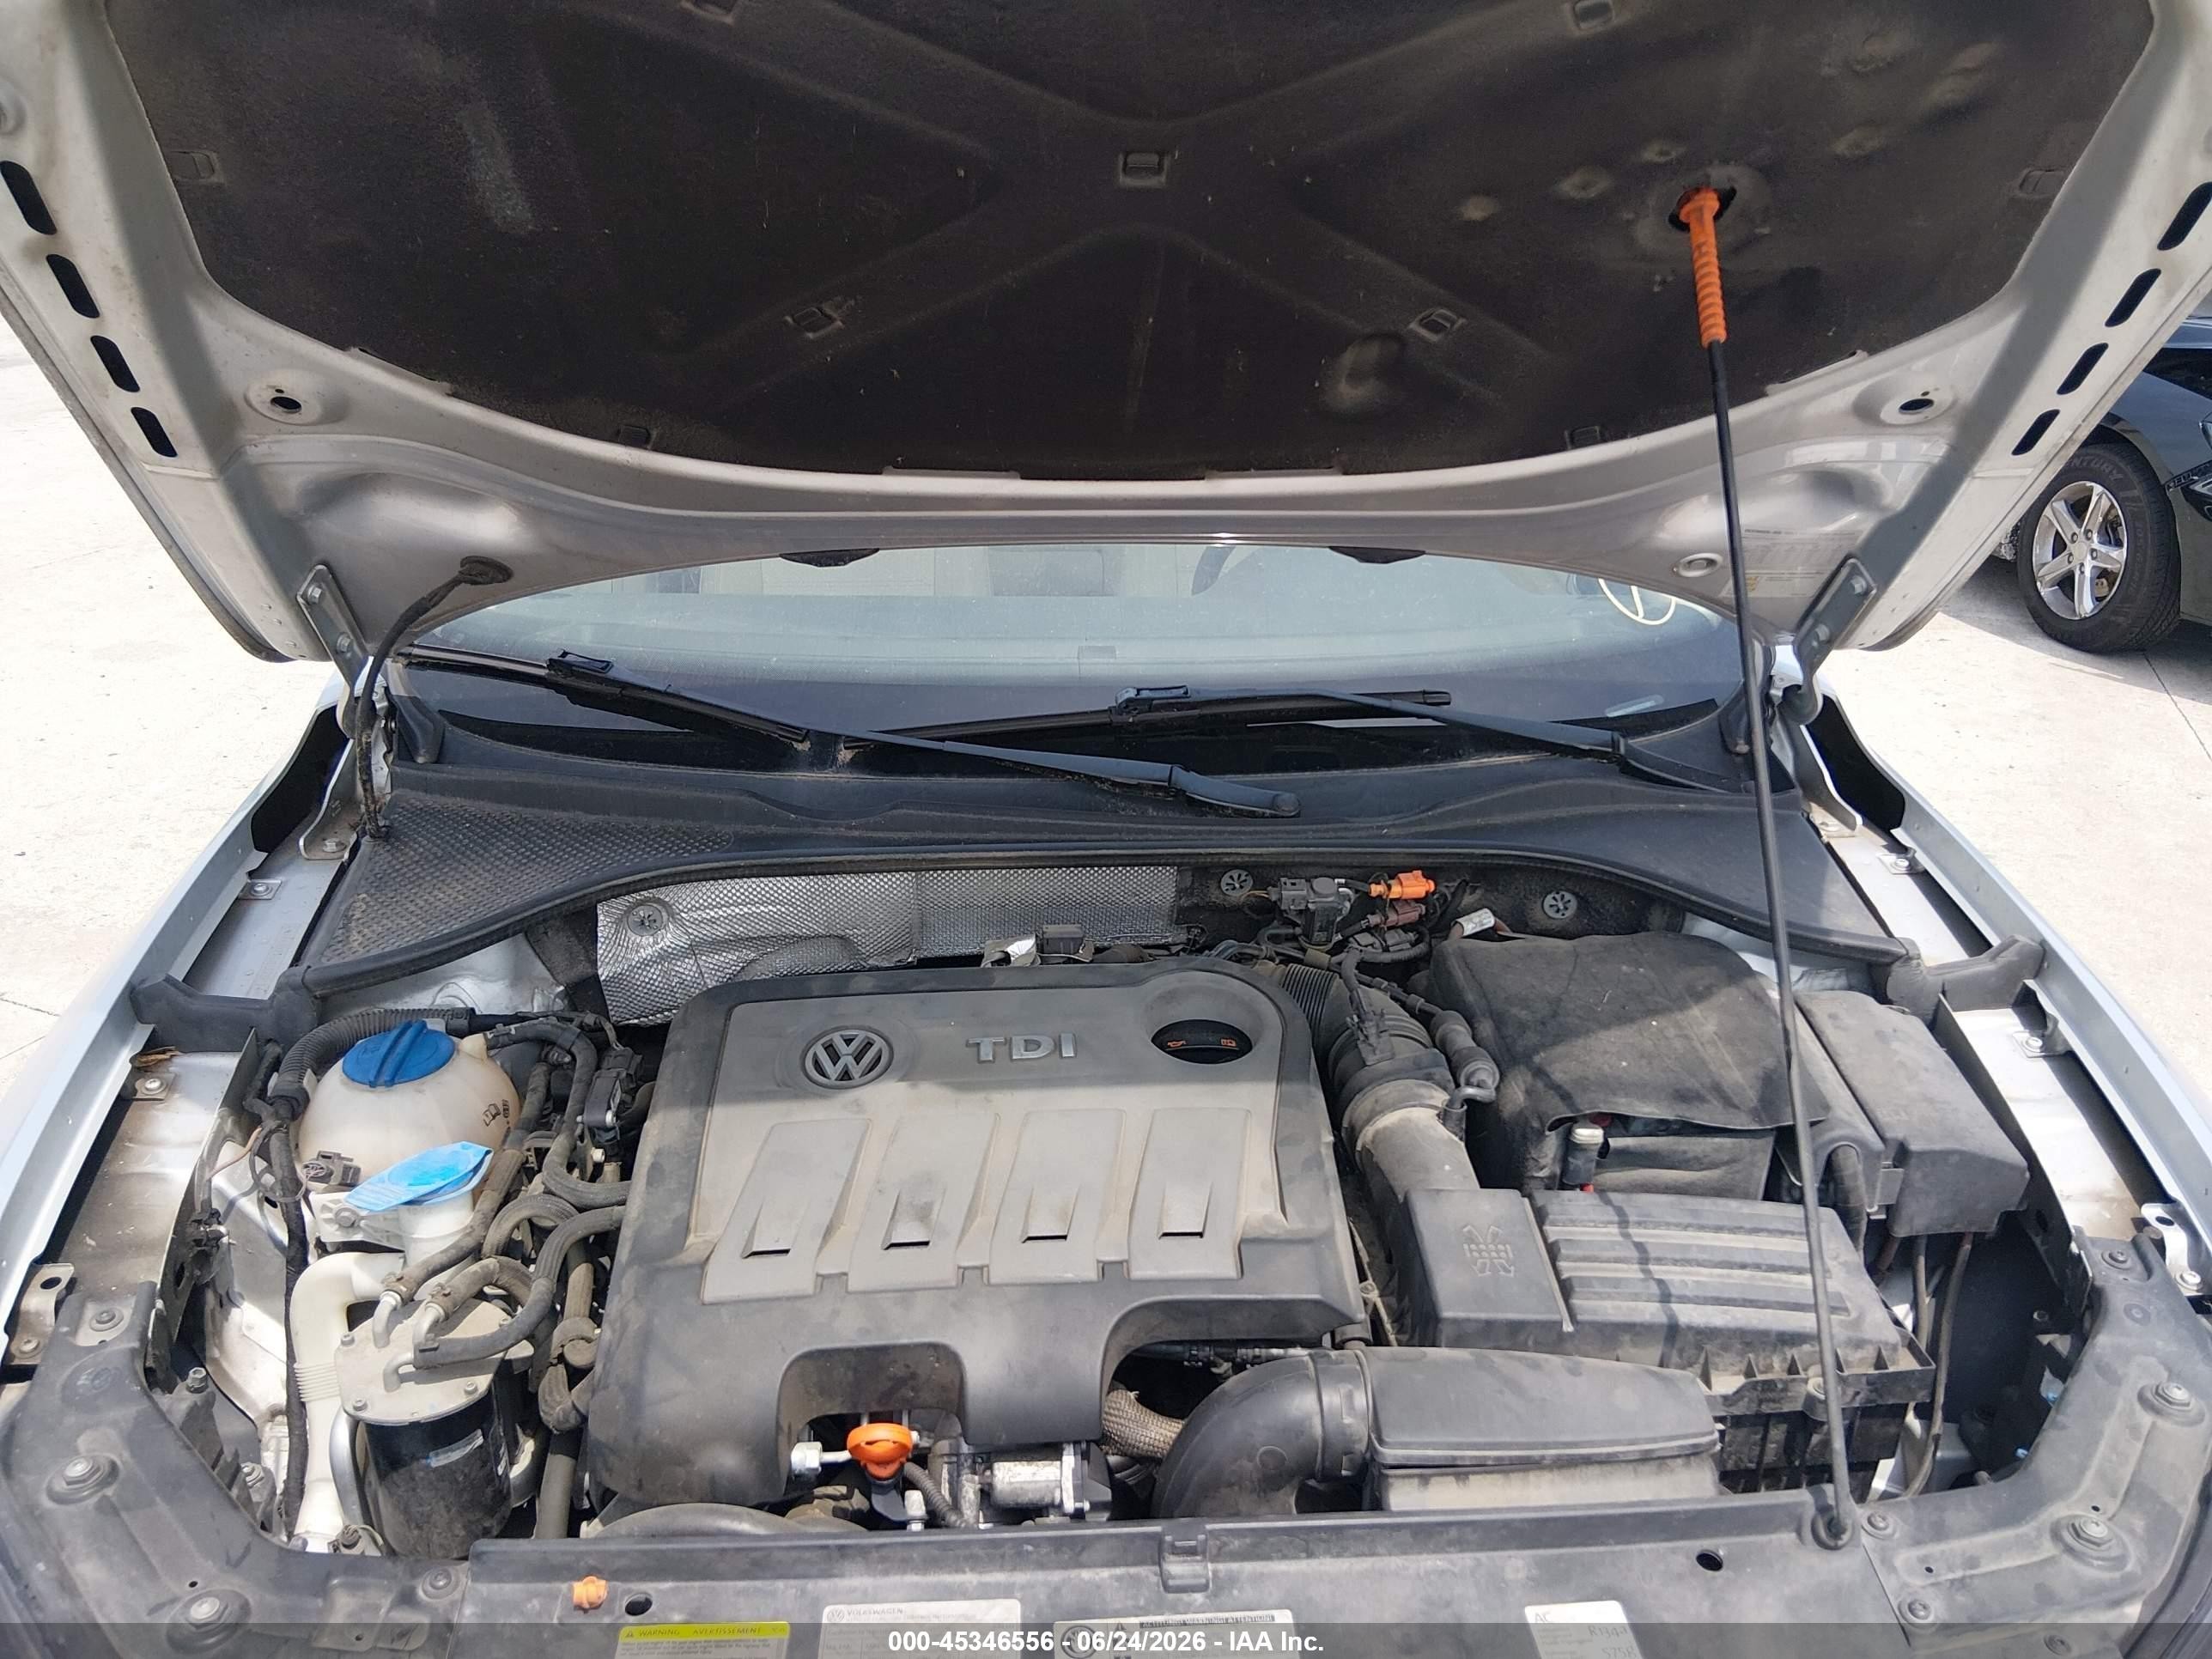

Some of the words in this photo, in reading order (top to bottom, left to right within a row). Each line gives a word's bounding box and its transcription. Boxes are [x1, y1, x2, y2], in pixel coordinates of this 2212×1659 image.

[967, 1033, 1076, 1061] TDI
[638, 1628, 681, 1637] WARNING
[691, 1626, 762, 1636] AVERTISSEMENT
